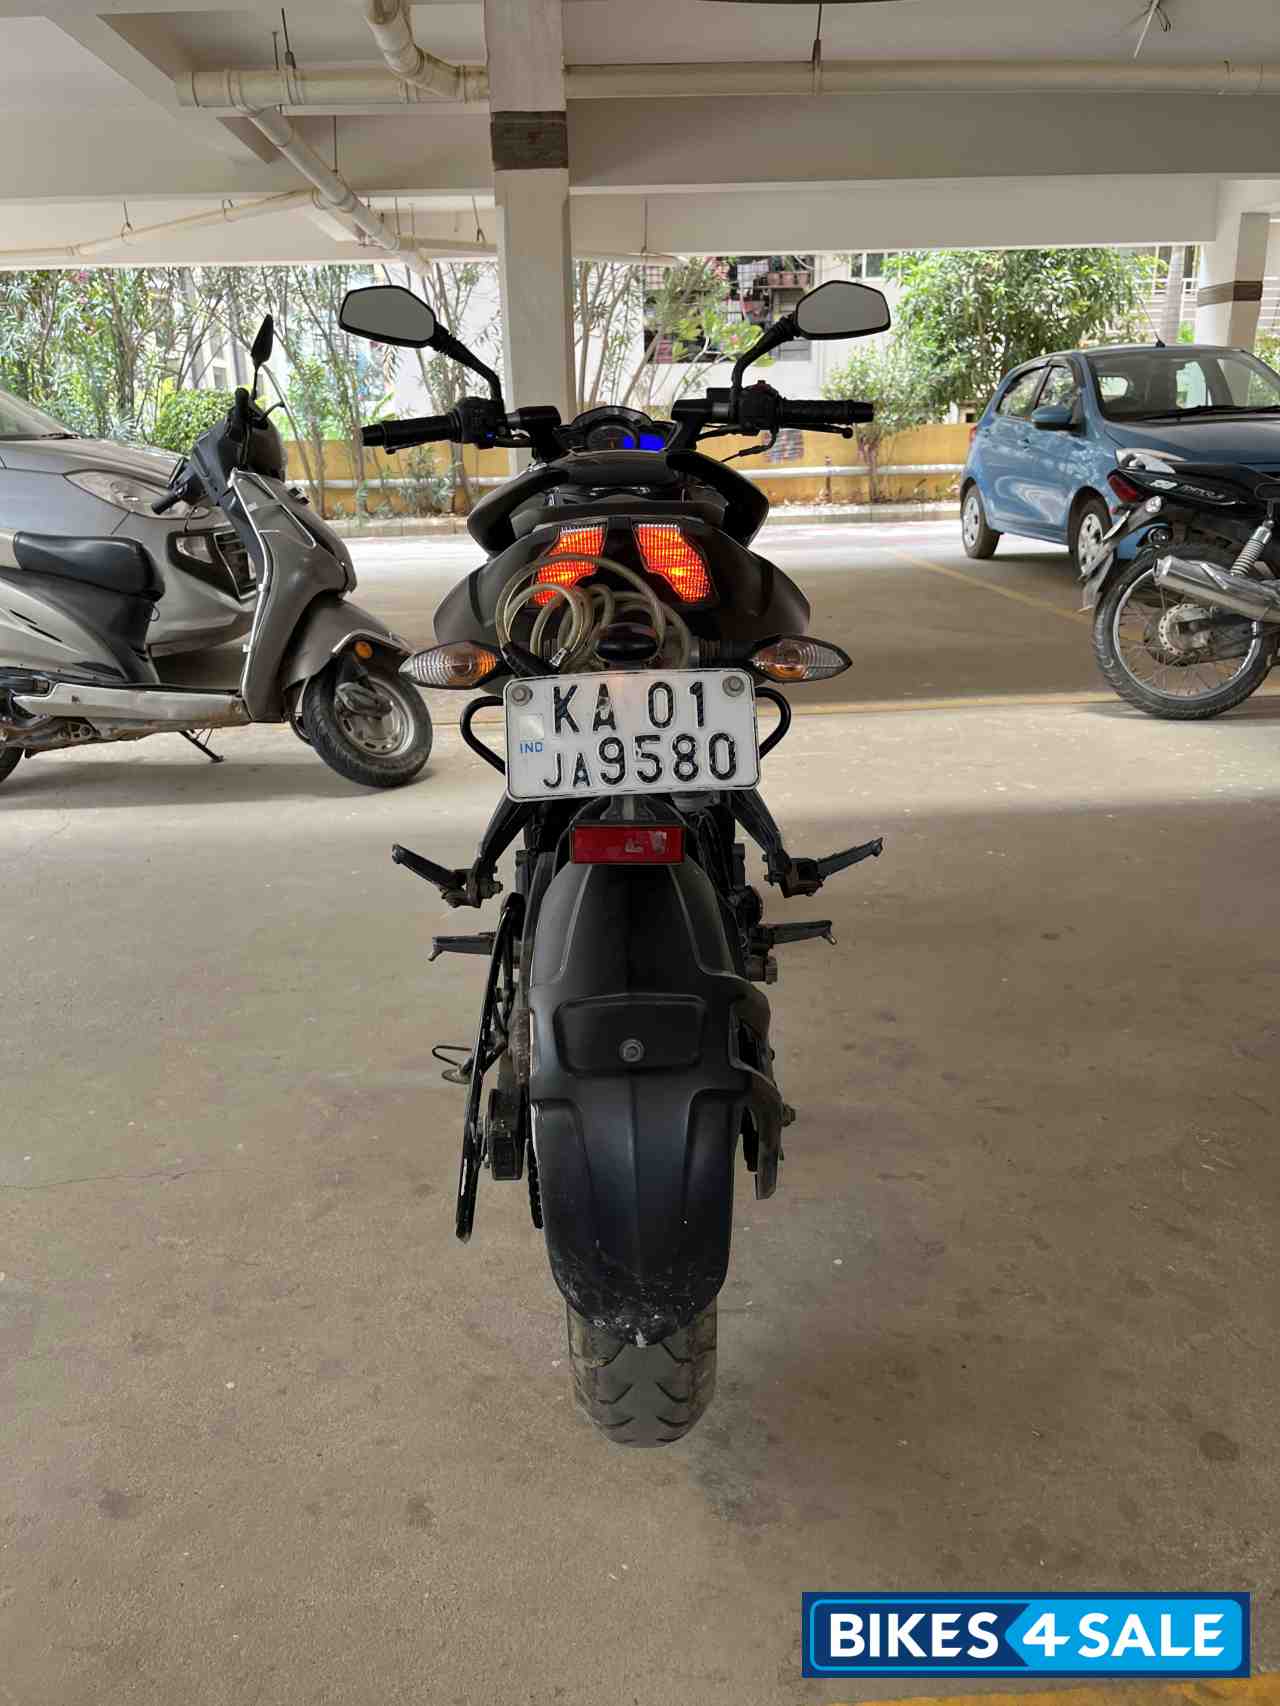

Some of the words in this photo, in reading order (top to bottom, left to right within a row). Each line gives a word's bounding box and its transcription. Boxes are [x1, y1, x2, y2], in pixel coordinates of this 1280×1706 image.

[553, 683, 616, 734] KA
[648, 681, 704, 728] 01
[520, 741, 544, 754] IND
